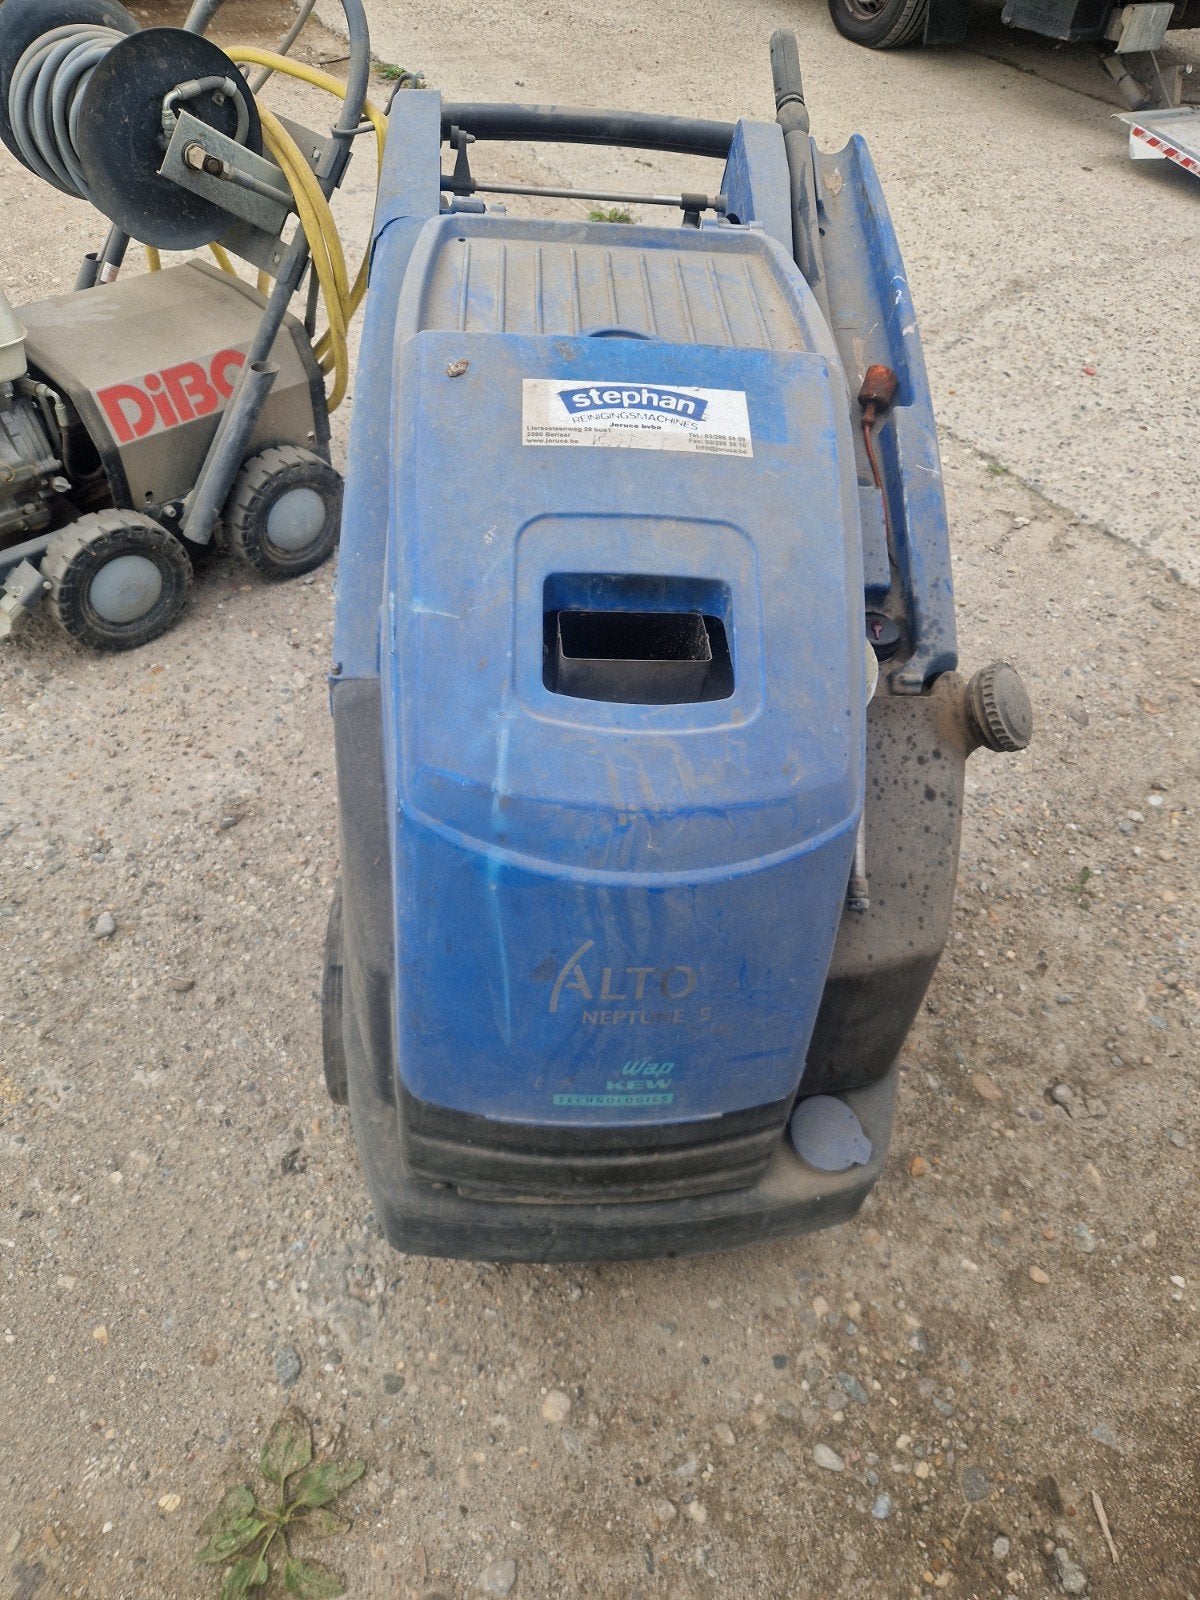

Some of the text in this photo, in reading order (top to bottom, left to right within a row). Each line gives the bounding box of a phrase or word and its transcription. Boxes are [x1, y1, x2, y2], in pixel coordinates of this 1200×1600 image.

[572, 388, 696, 415] stephan
[572, 411, 698, 431] REINIGINGSMACHINES
[549, 939, 696, 1013] ALTO
[583, 1007, 712, 1025] NEPTUNE 5
[622, 1060, 674, 1077] Wap
[606, 1078, 673, 1090] KEW
[558, 1094, 669, 1104] TECHNOLOGIES
